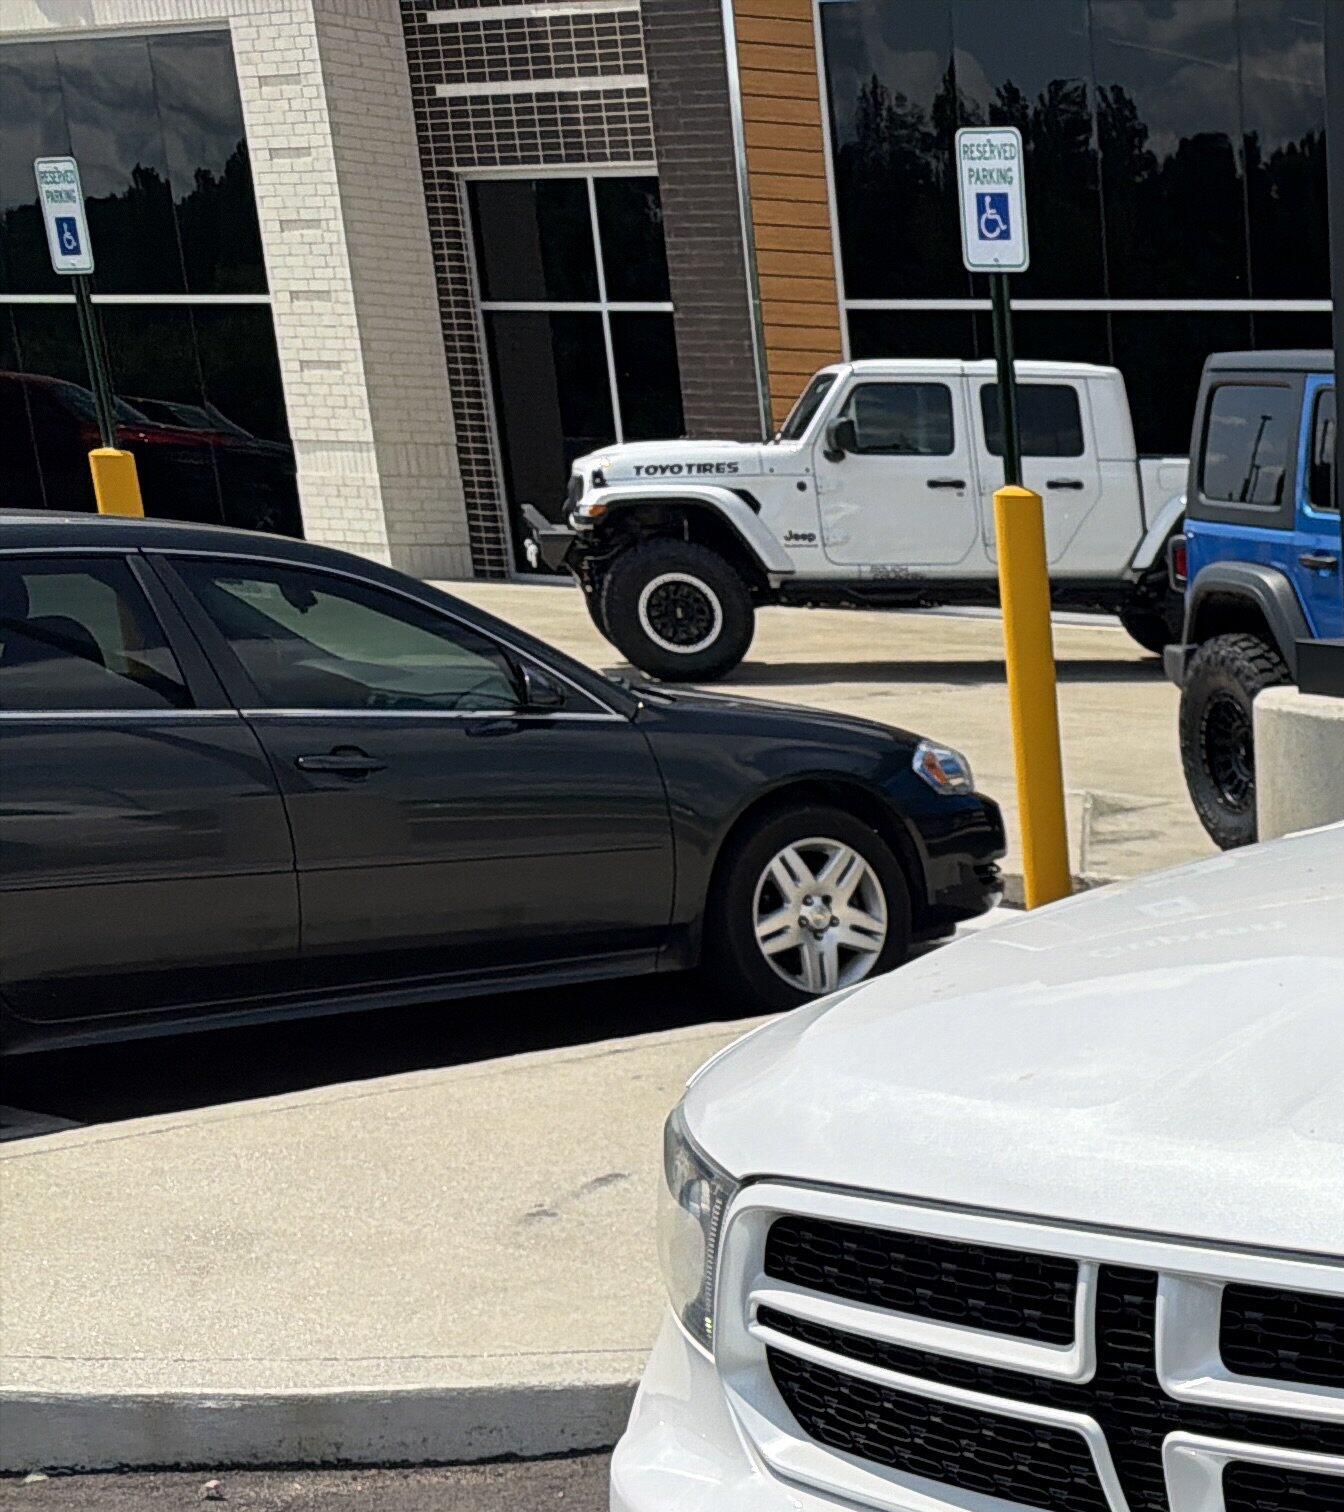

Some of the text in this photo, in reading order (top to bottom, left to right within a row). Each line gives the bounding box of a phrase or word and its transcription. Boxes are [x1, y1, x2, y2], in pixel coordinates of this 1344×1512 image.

[962, 143, 1016, 160] RESERVED
[968, 167, 1013, 185] PARKING
[633, 461, 739, 476] TOYO TIRES
[784, 530, 817, 542] Jeep
